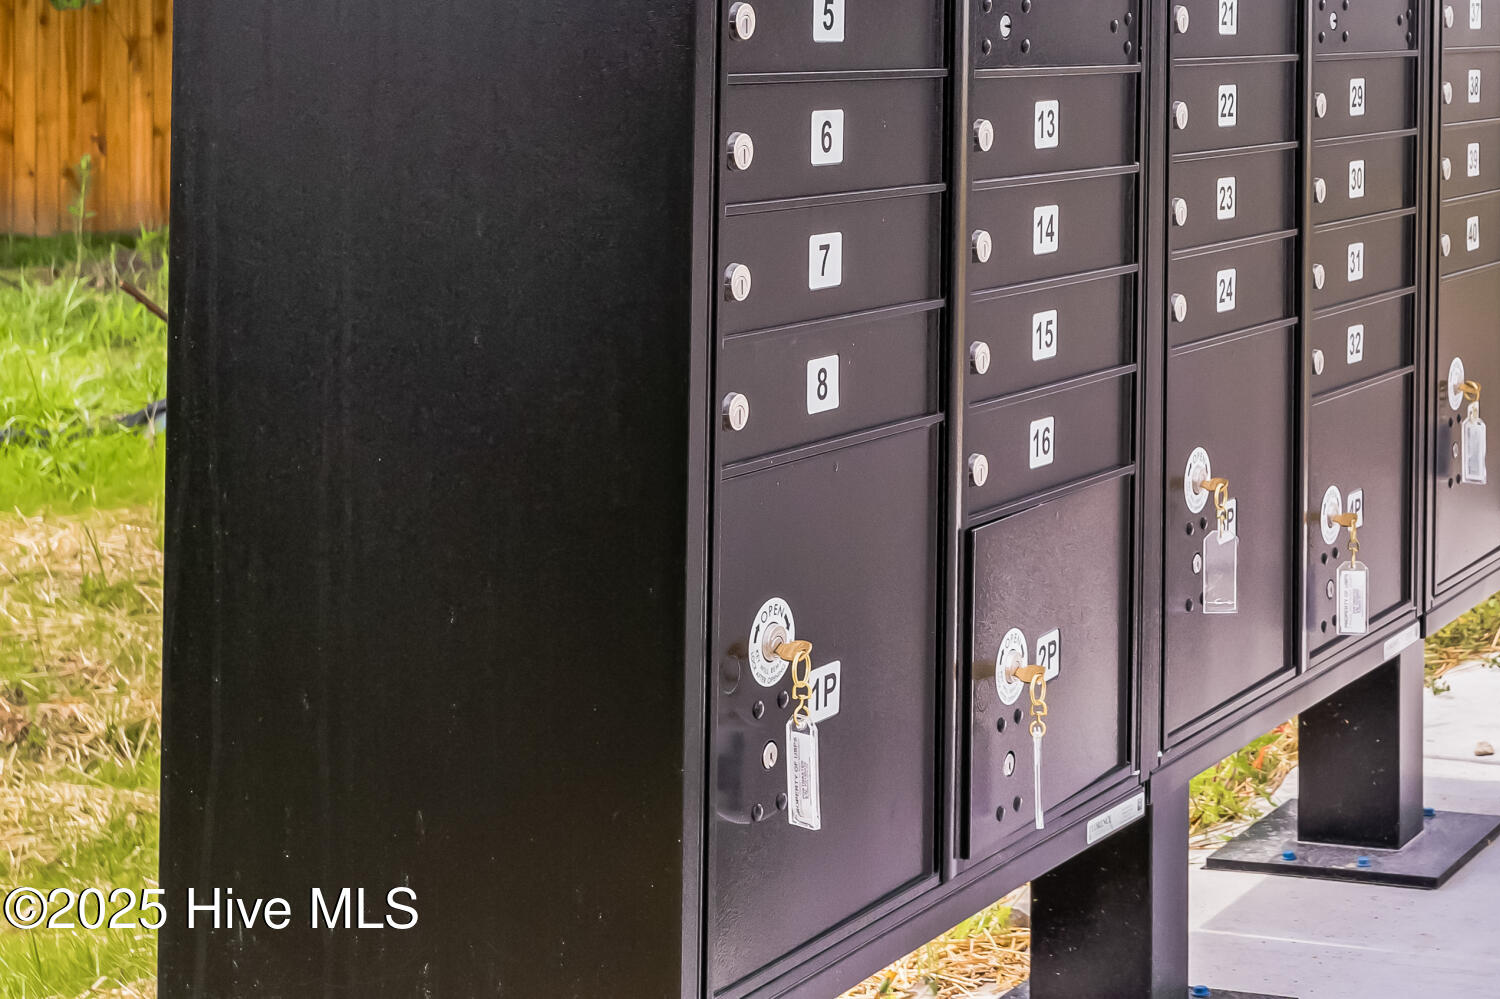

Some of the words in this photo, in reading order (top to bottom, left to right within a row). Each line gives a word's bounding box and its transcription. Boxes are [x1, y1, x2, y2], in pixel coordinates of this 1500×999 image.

[1221, 1, 1234, 26] 21
[1471, 2, 1480, 23] 37
[1351, 85, 1363, 108] 29
[1470, 75, 1479, 96] 38
[1220, 92, 1234, 118] 22
[821, 120, 832, 154] 6
[1037, 109, 1055, 139] 13
[1469, 149, 1478, 170] 39
[1351, 167, 1363, 191] 30
[1219, 185, 1233, 211] 23
[1037, 214, 1055, 244] 14
[1468, 223, 1477, 244] 40
[819, 243, 831, 277] 7
[1350, 249, 1361, 274] 31
[1219, 277, 1233, 304] 24
[1036, 319, 1054, 350] 15
[1349, 331, 1361, 356] 32
[816, 367, 828, 401] 8
[1033, 426, 1051, 458] 16
[761, 603, 785, 623] OPEN
[1039, 640, 1057, 670] 2P
[812, 672, 837, 711] 1P
